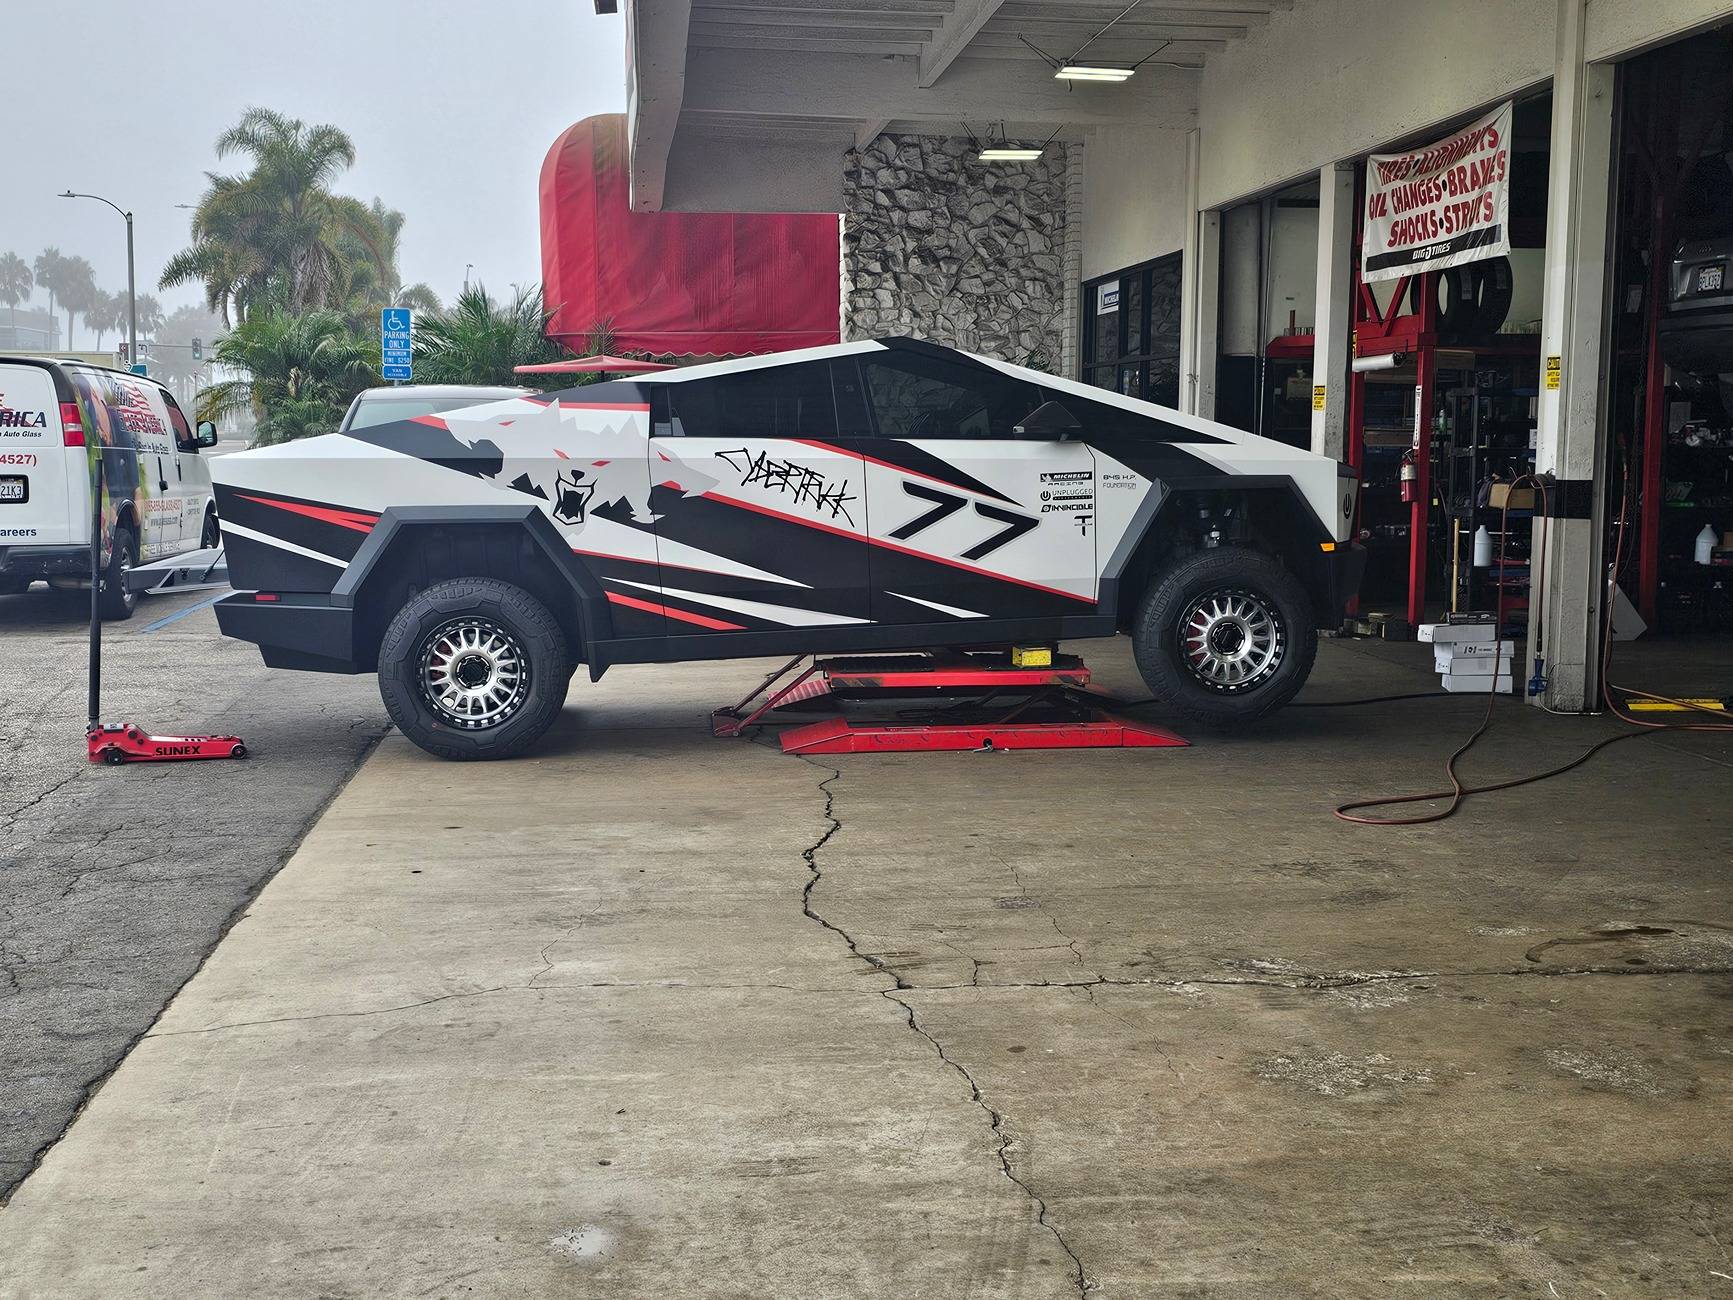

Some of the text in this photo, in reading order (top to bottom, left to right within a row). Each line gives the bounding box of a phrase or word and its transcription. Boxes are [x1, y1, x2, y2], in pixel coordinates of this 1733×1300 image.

[1377, 124, 1499, 186] TIRES ALIGNMENTS
[1368, 150, 1507, 220] OIL CHANGES BRAKES
[1387, 191, 1494, 247] SHOCKS STRUTS
[1431, 241, 1451, 256] TIRES
[384, 331, 409, 340] PARKING
[388, 340, 405, 349] ONLY
[3, 430, 42, 438] Auto Glass
[0, 454, 37, 467] 4527)
[0, 486, 22, 496] 21K3
[1052, 488, 1093, 496] UNPLUGGED
[1052, 503, 1093, 511] INVINCIBLE
[886, 480, 1040, 561] 77
[0, 529, 37, 537] areers
[155, 745, 201, 756] SUNEX
